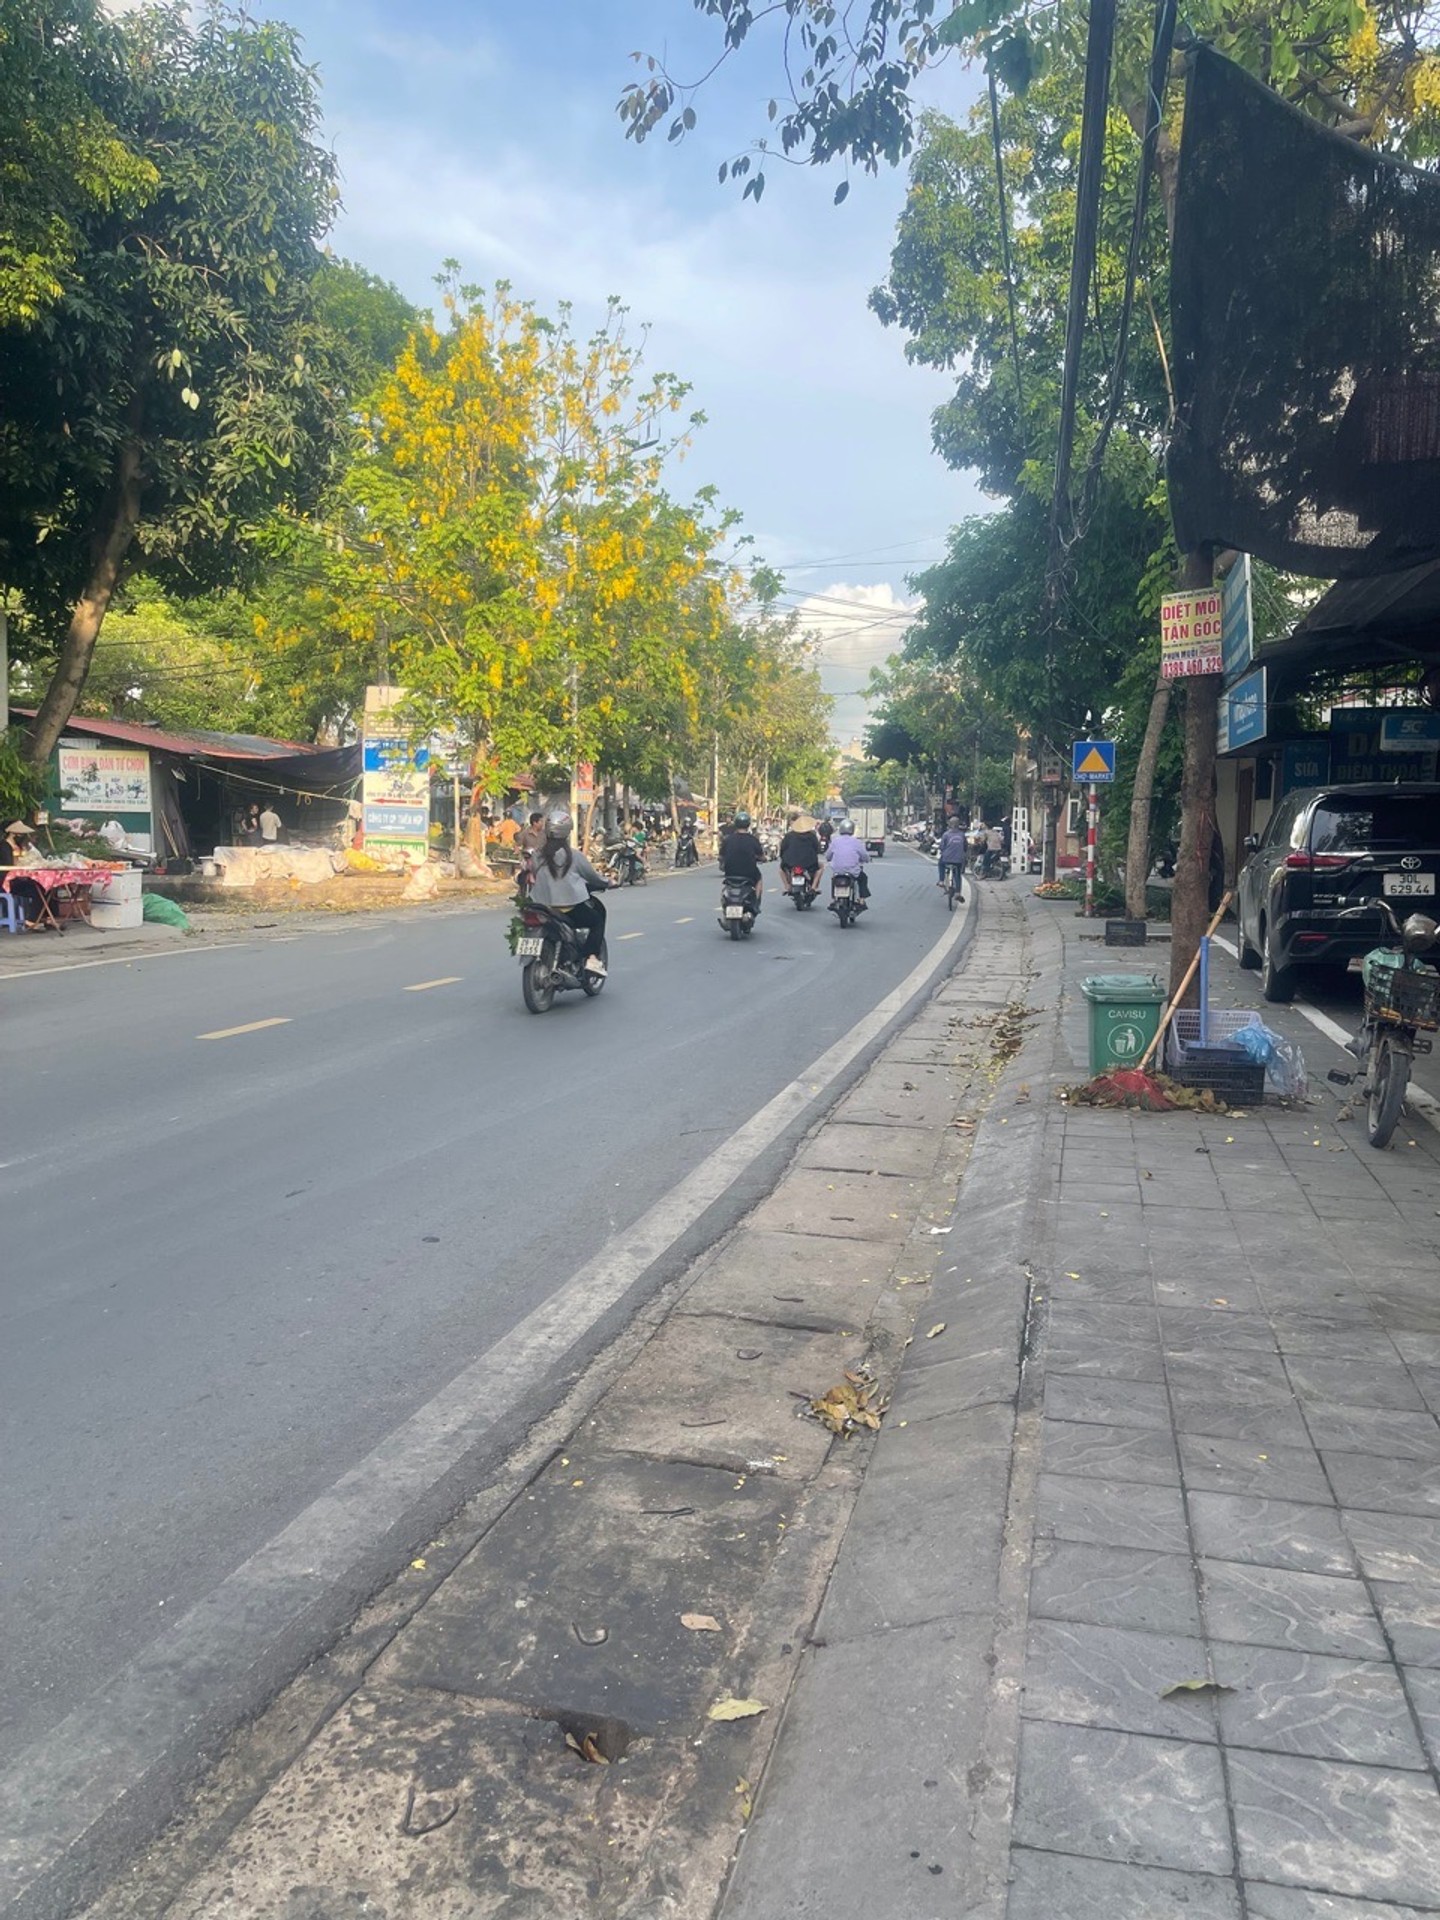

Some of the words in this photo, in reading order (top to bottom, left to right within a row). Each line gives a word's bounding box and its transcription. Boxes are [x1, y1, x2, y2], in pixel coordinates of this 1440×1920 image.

[1163, 602, 1191, 622] DIỆT
[1195, 594, 1220, 616] MỐI
[1163, 623, 1189, 643] TẬN
[1194, 616, 1221, 637] GỐC
[1399, 874, 1421, 884] 30L
[1390, 884, 1430, 894] 629.44
[1108, 1009, 1146, 1019] CAVISU
